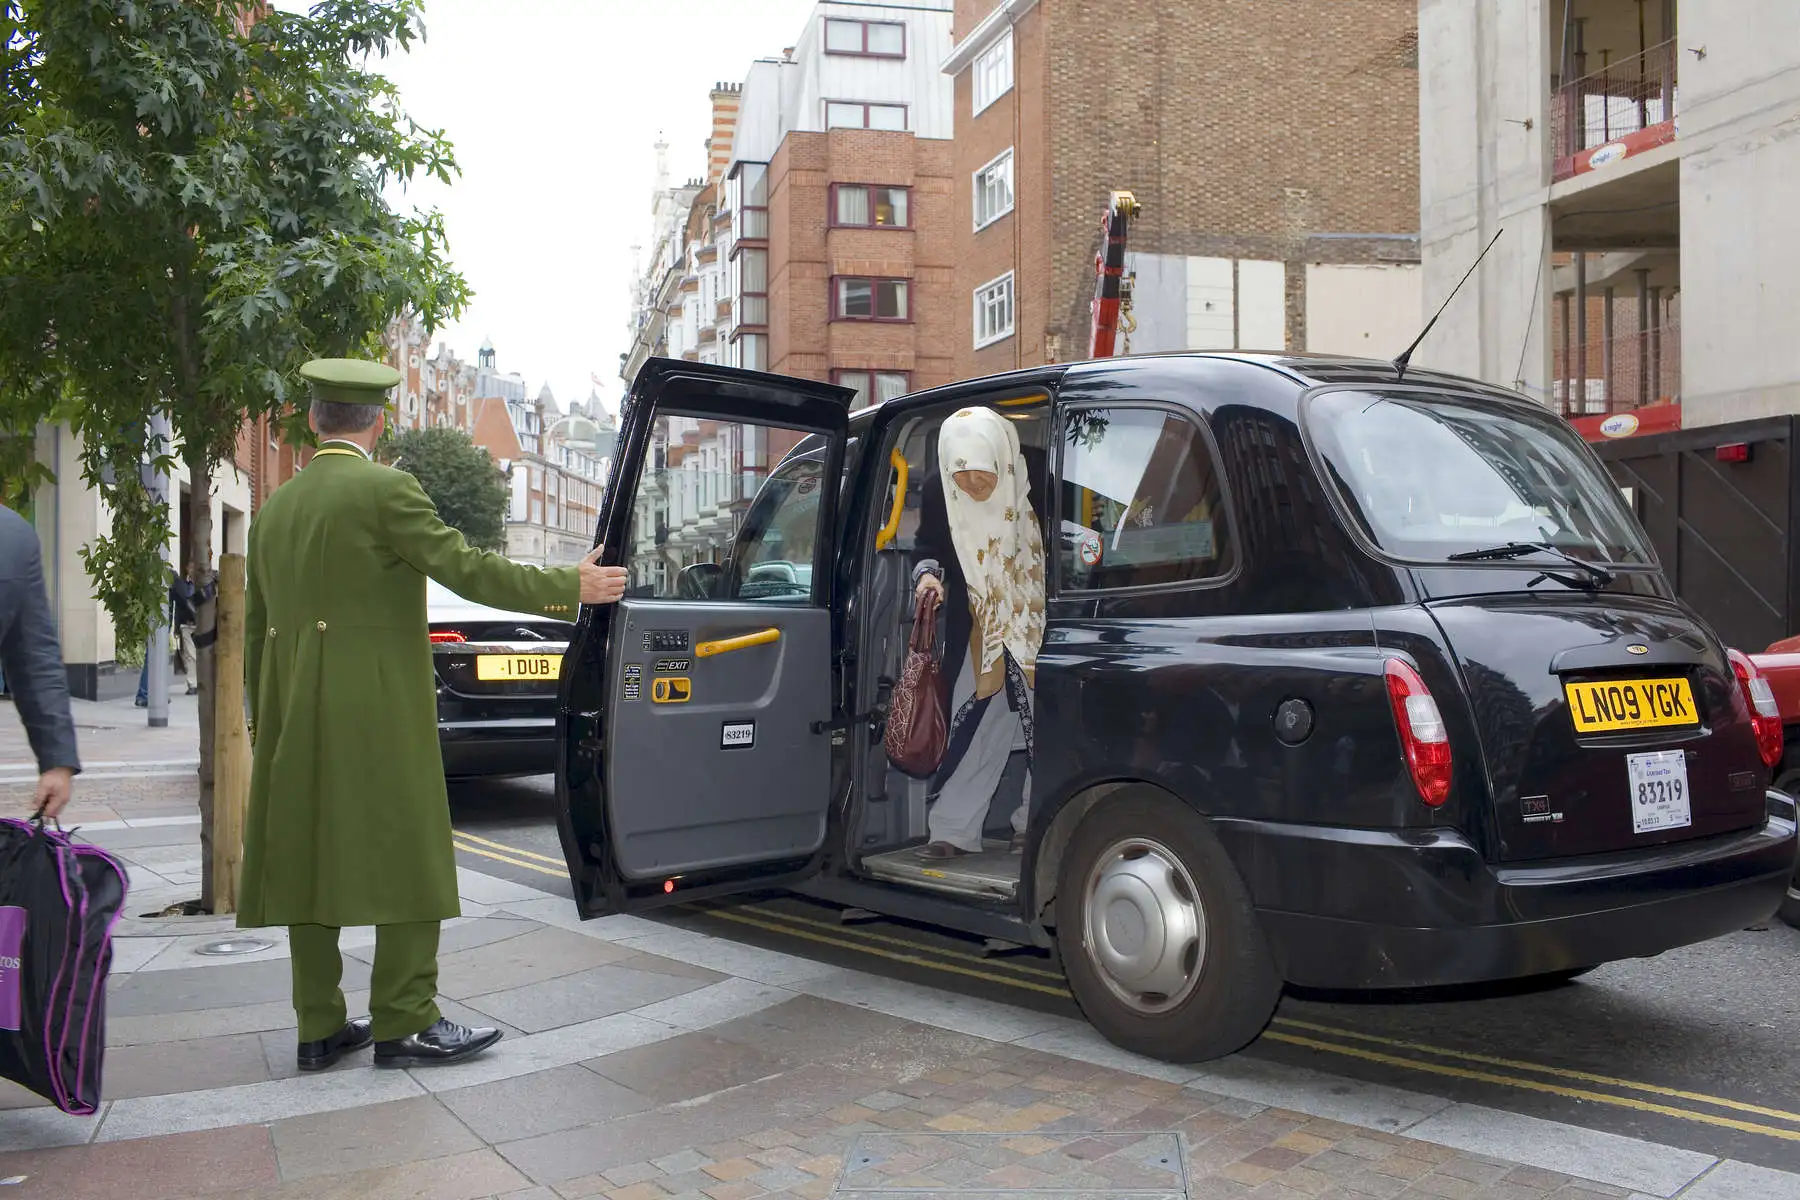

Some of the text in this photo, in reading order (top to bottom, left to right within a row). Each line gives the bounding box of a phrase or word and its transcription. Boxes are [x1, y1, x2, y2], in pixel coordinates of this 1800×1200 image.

[517, 659, 550, 675] DUB
[668, 661, 689, 670] EXIT
[1575, 683, 1688, 724] LN09 YGK
[726, 729, 751, 739] 83219
[1638, 778, 1682, 805] 83219
